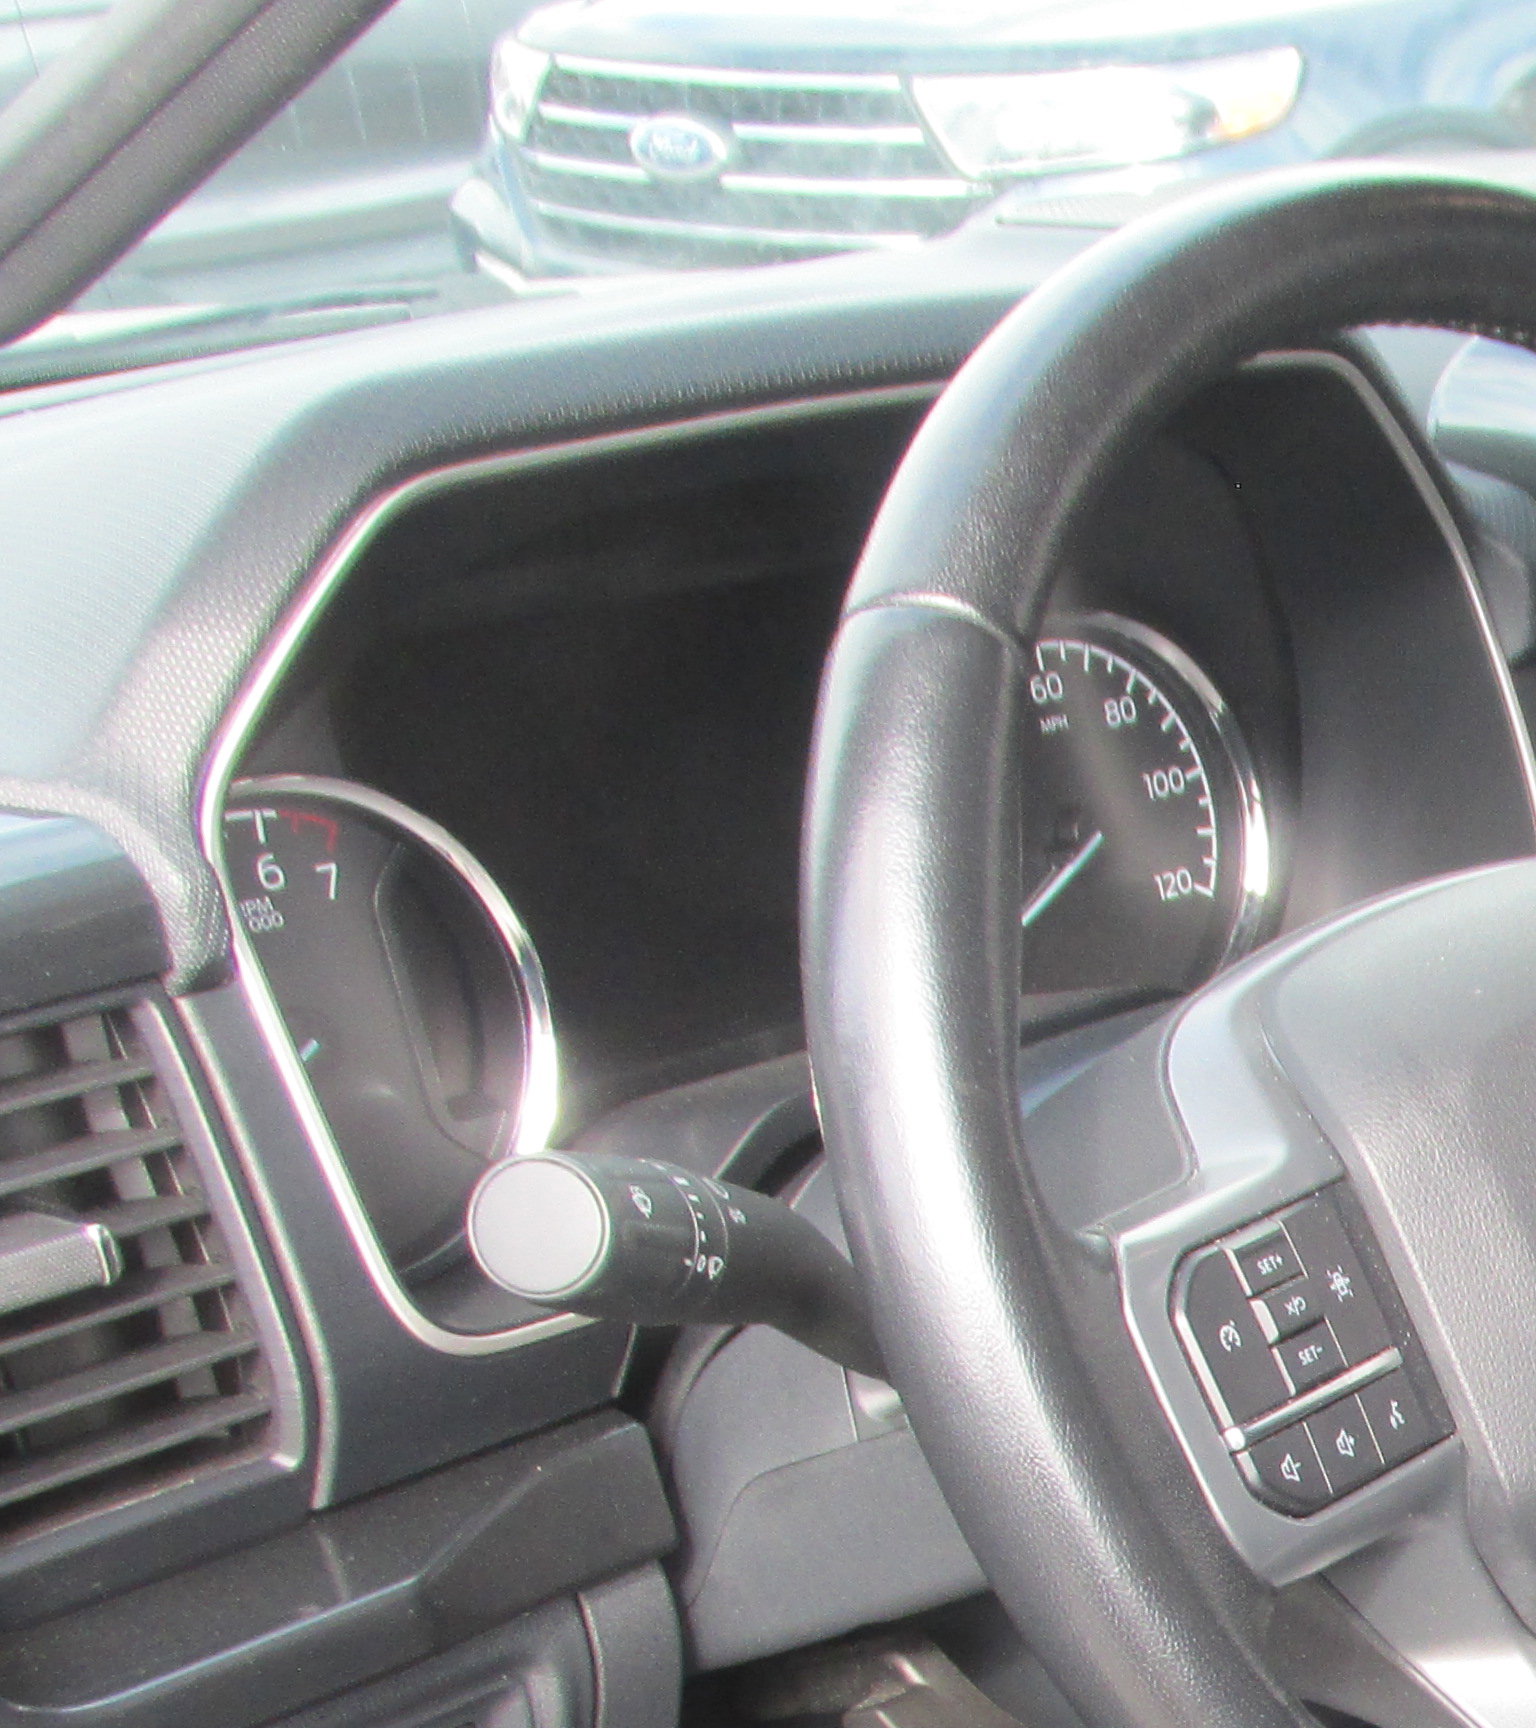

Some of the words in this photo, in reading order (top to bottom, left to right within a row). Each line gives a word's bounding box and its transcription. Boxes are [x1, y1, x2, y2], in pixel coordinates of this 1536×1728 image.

[1030, 671, 1063, 703] 60
[1040, 714, 1069, 733] MPH
[1104, 696, 1137, 728] 80
[1142, 767, 1185, 800] 100
[256, 853, 285, 890] 6
[315, 863, 337, 900] 7
[1154, 866, 1193, 901] 120
[1257, 1253, 1283, 1275] SET+
[1298, 1345, 1323, 1365] SET-
